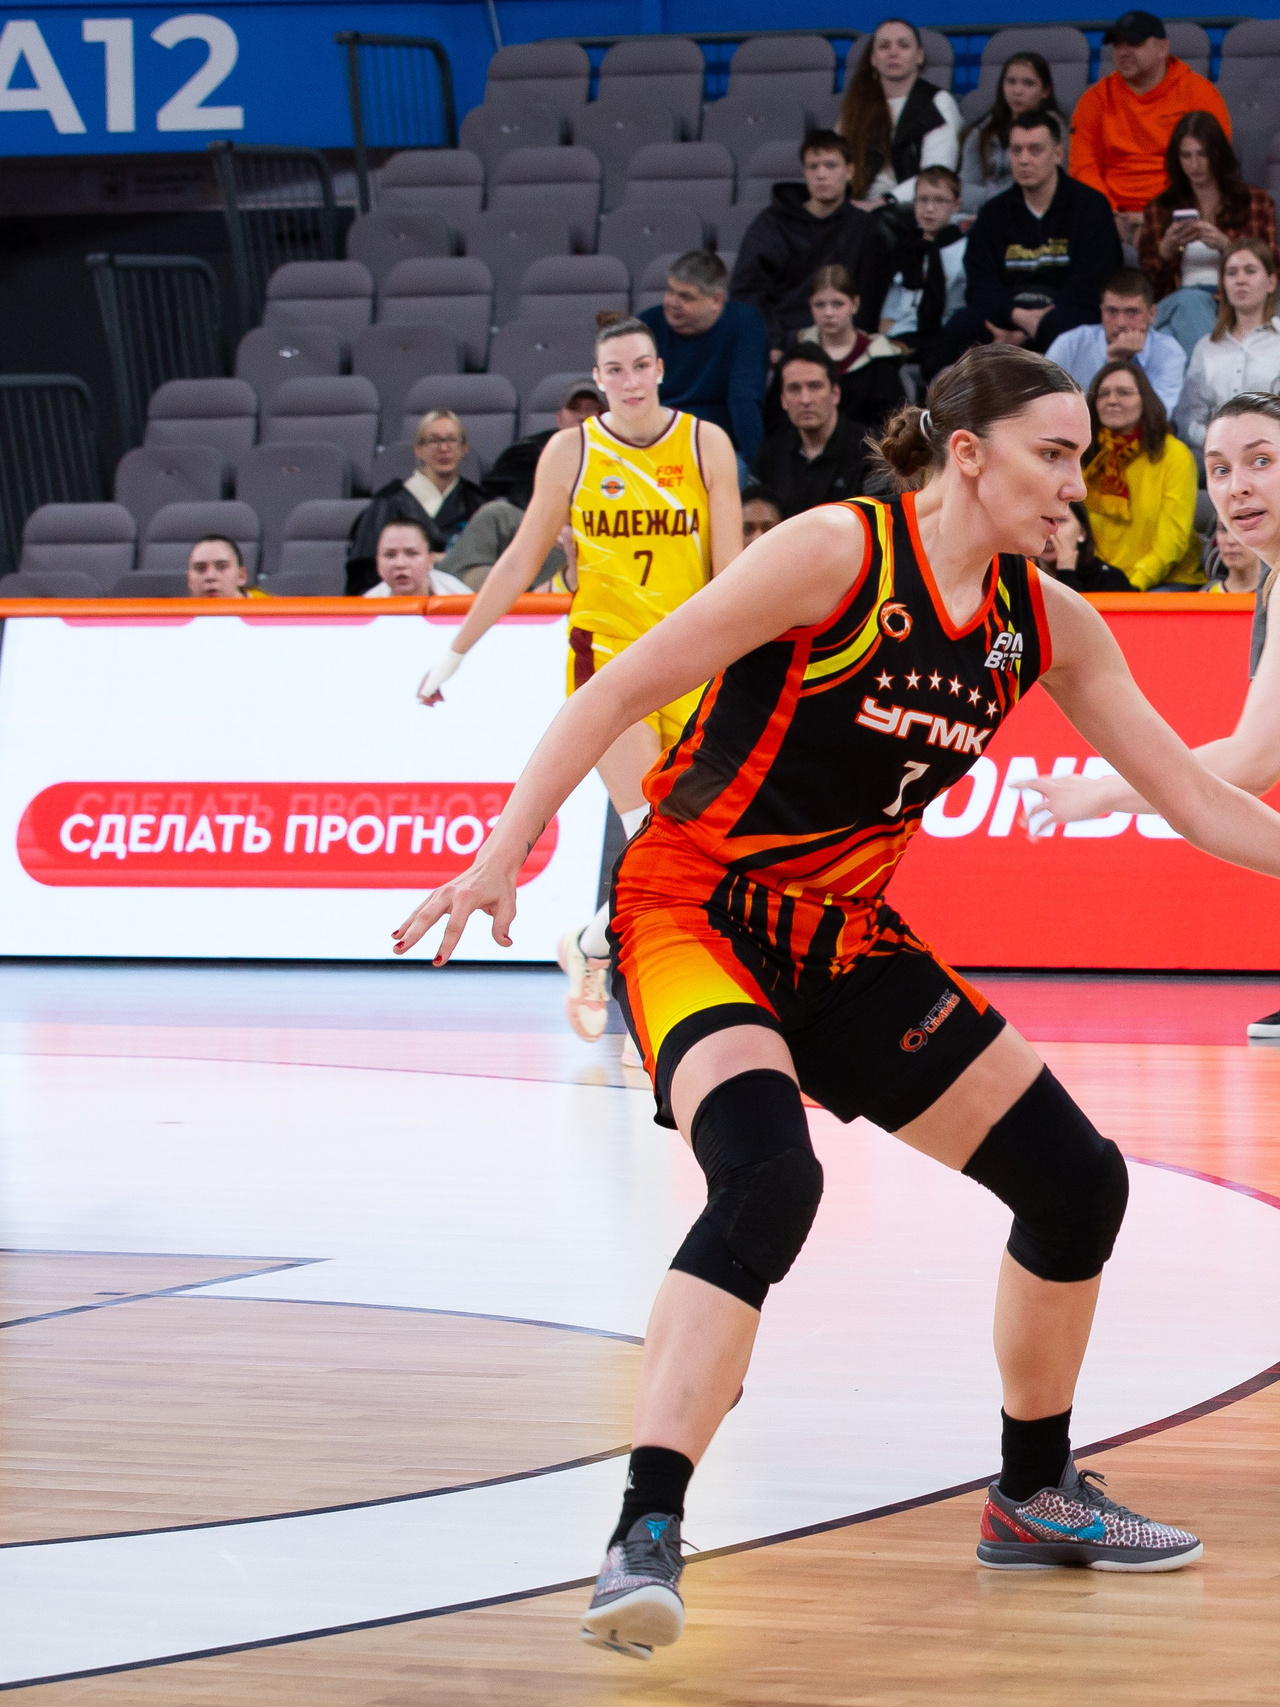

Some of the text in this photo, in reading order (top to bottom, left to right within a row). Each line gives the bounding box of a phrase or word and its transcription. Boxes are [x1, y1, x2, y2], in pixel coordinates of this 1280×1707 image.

[0, 13, 244, 134] A12
[656, 464, 684, 476] FON
[657, 476, 685, 488] BET
[582, 508, 700, 538] НАДЕЖДА
[633, 550, 653, 587] 7
[854, 695, 993, 755] УГМК
[882, 760, 931, 817] 7
[59, 813, 501, 860] СДЕЛАТЬ ПРОГНО
